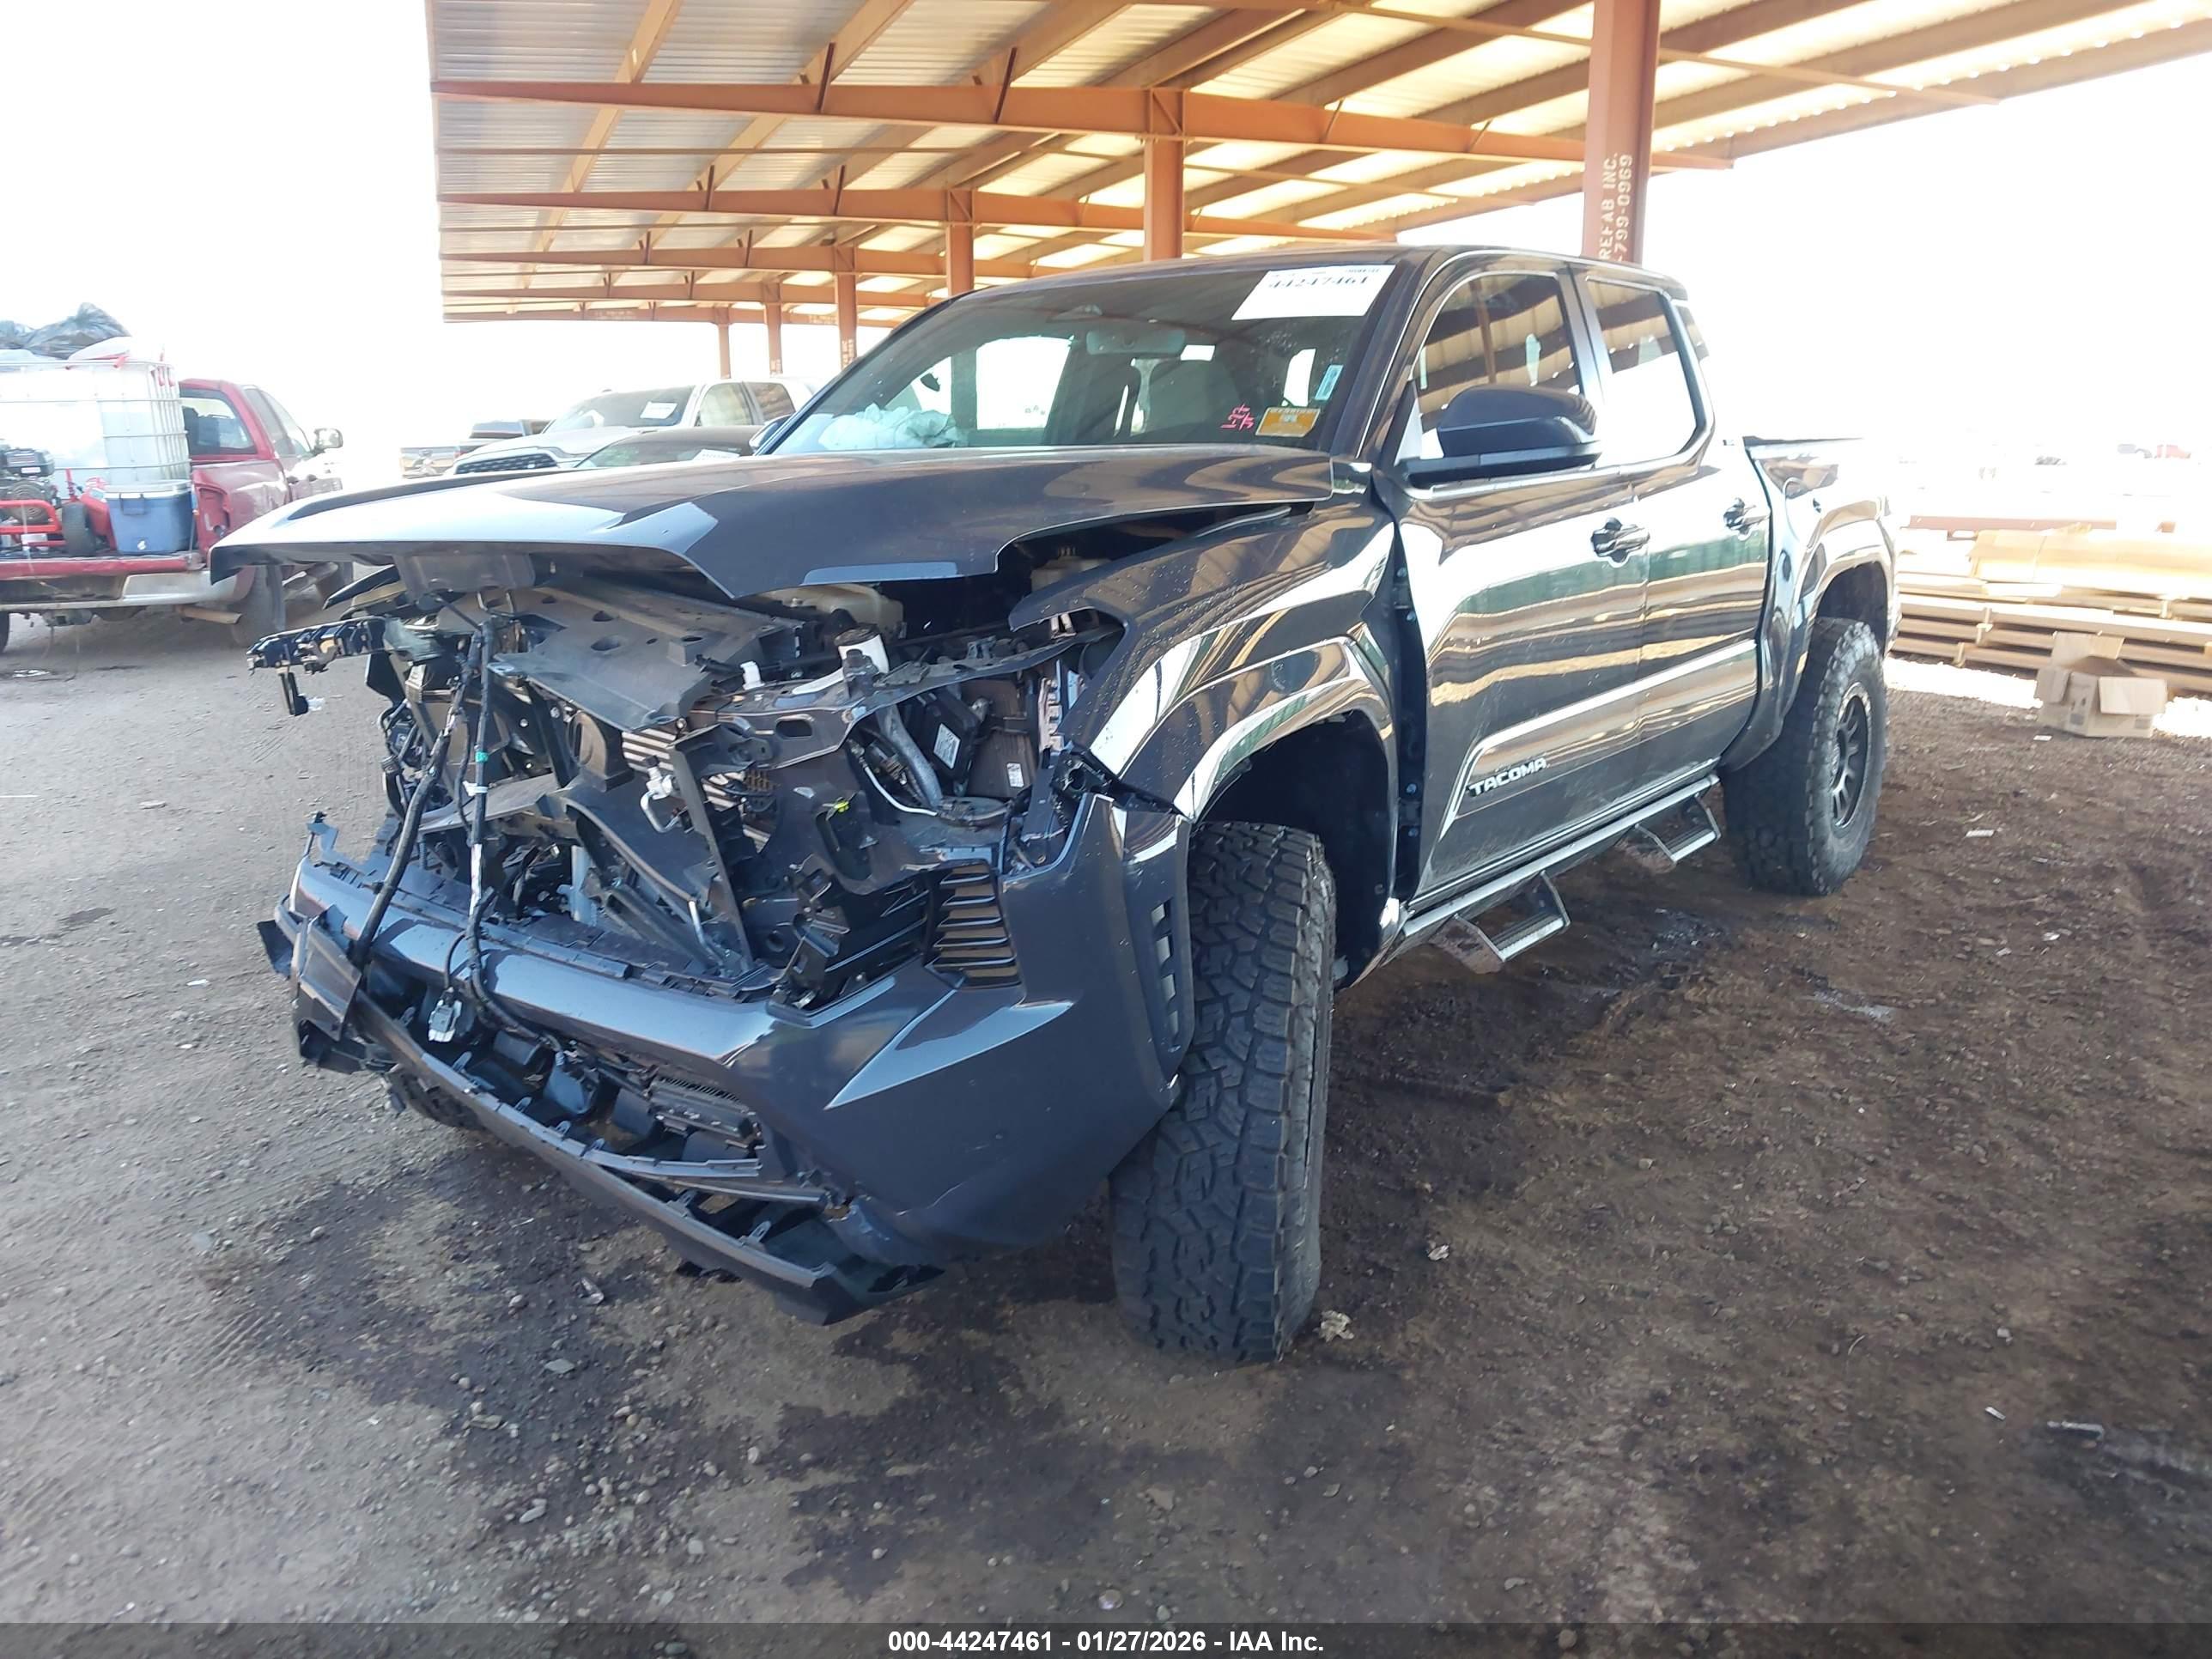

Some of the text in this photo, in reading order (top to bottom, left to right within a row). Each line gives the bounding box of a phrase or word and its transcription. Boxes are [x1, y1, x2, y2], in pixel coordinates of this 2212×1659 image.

[1599, 152, 1618, 259] REFAB INC.
[1468, 757, 1547, 796] TACOMA
